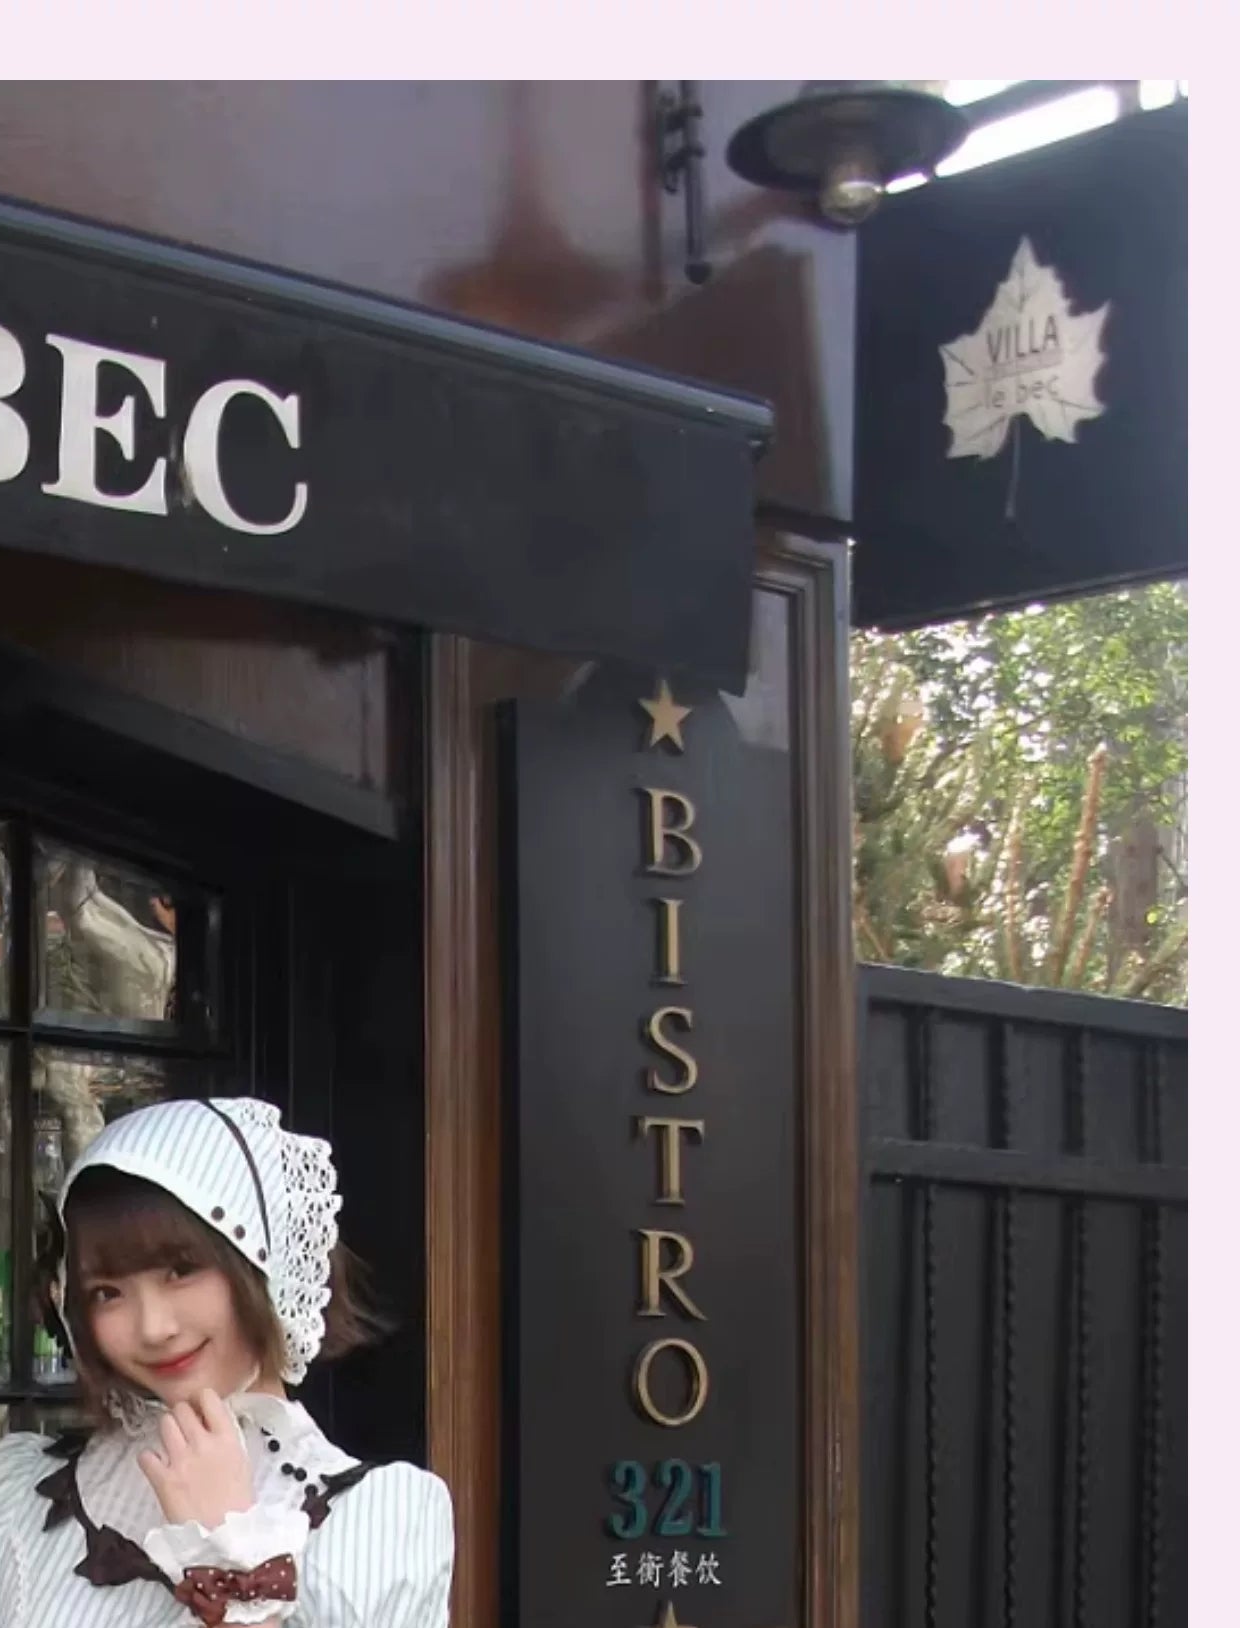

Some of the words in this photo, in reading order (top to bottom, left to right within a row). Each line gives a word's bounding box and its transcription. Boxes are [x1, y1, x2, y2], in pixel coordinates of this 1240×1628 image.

[986, 315, 1060, 364] VILLA
[985, 384, 1006, 410] le
[1015, 374, 1060, 404] bec
[634, 787, 709, 1426] BISTRO
[609, 1460, 727, 1539] 321
